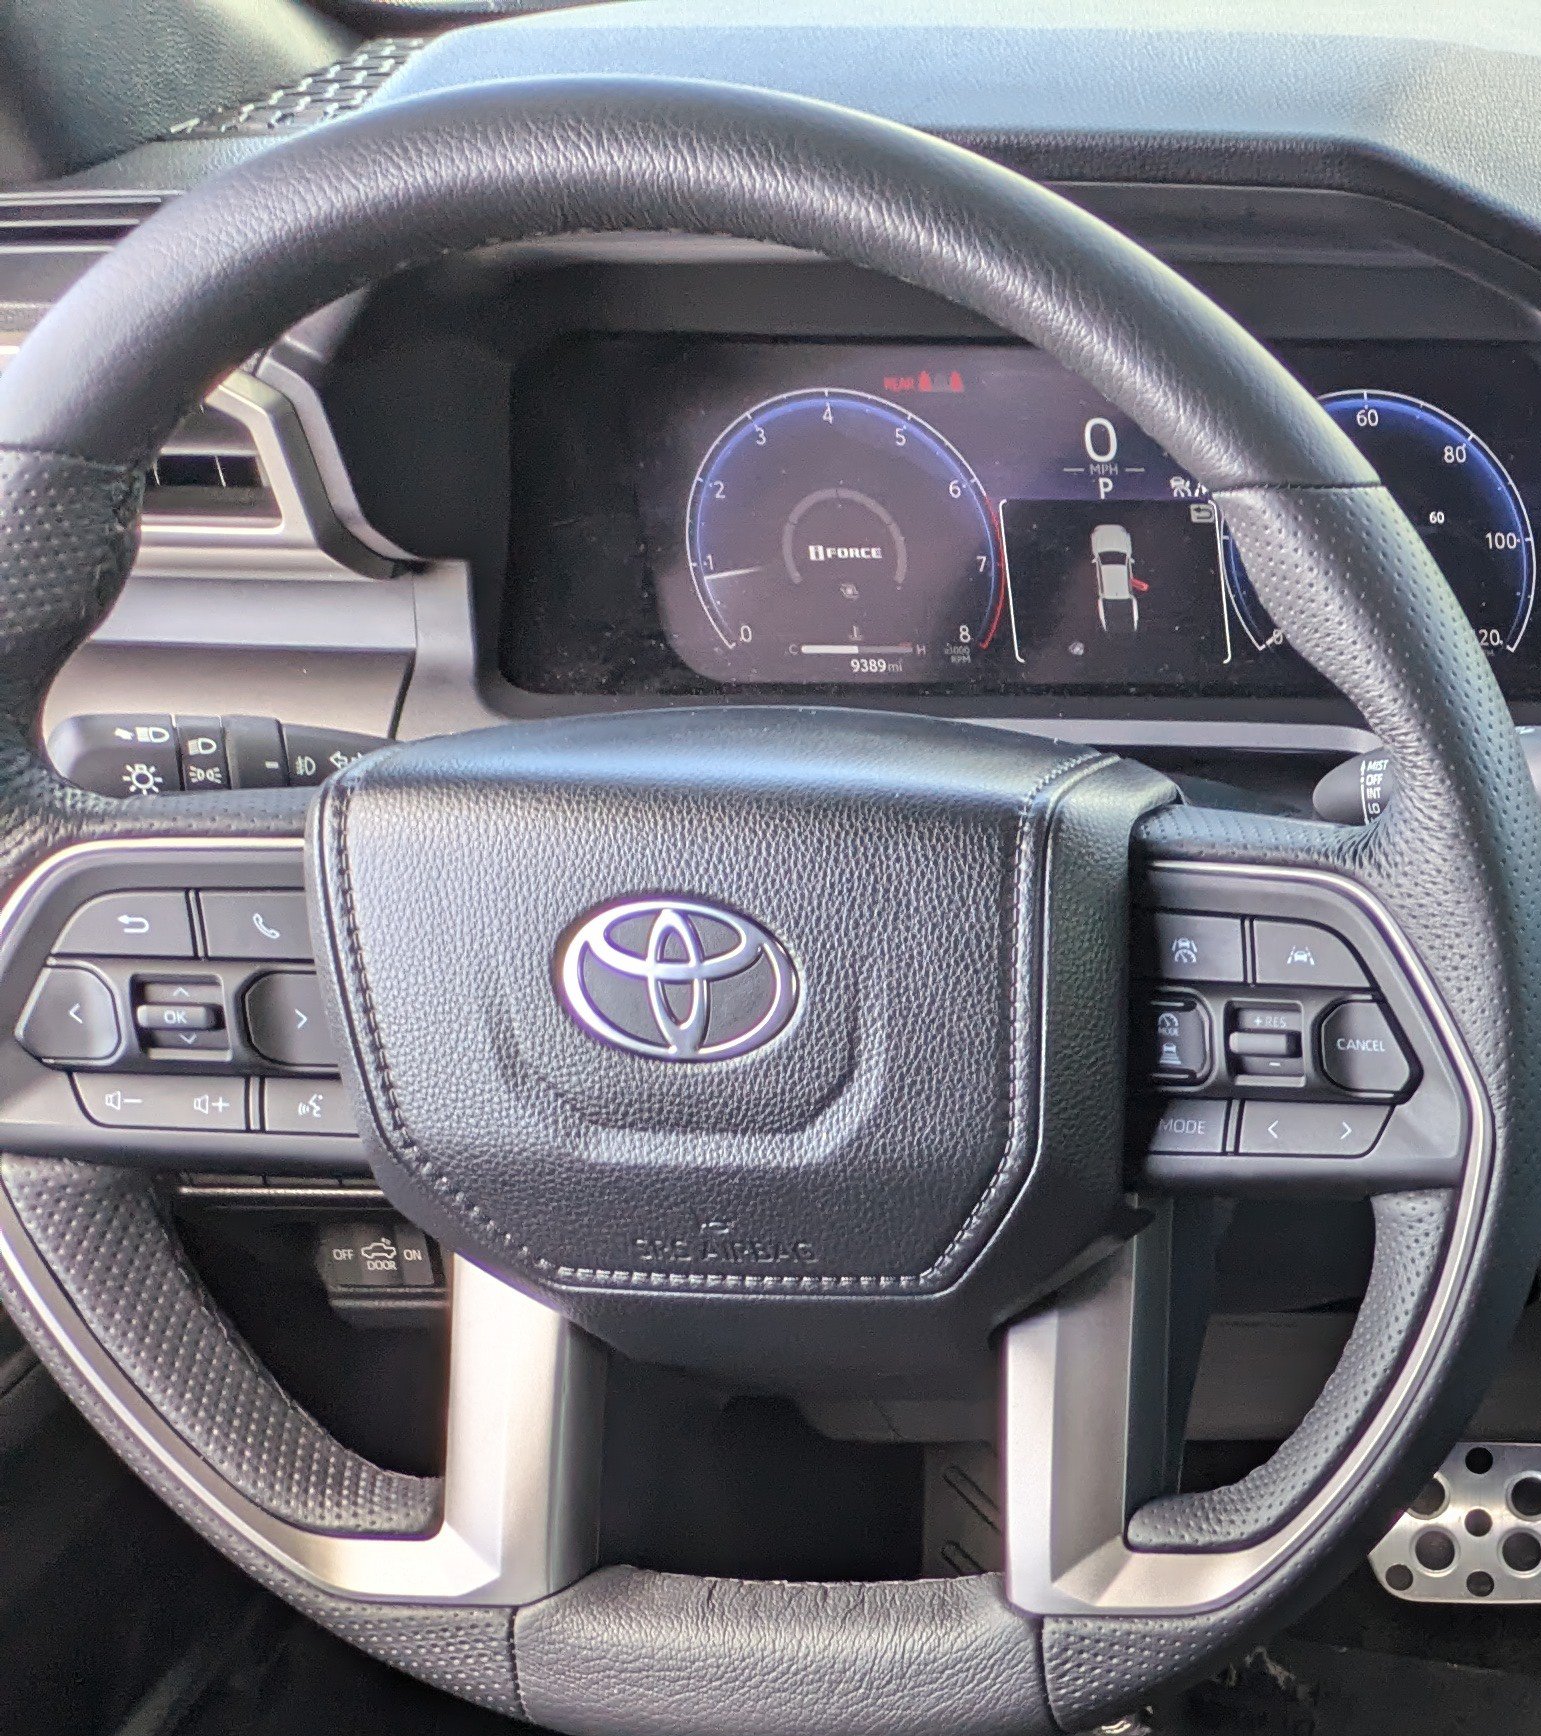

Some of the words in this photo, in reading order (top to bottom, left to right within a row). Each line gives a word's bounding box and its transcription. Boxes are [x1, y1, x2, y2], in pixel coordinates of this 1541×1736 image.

[822, 408, 833, 425] 4
[1356, 409, 1379, 427] 60
[756, 428, 767, 446] 3
[895, 428, 906, 446] 5
[1084, 417, 1117, 462] 0
[1443, 446, 1467, 464] 80
[1090, 463, 1118, 475] MPH
[714, 481, 725, 499] 2
[949, 480, 962, 498] 6
[1099, 477, 1113, 499] P
[1429, 511, 1445, 524] 60
[1485, 531, 1516, 550] 100
[826, 546, 883, 559] FORCE
[706, 556, 715, 571] 1
[977, 557, 987, 572] 7
[740, 626, 752, 643] 0
[959, 625, 971, 643] 8
[1478, 629, 1500, 646] 20
[850, 659, 886, 673] 9389
[1367, 759, 1389, 771] MIST
[1366, 773, 1383, 786] OFF
[1366, 787, 1381, 799] INT
[164, 1010, 187, 1024] OK
[1337, 1038, 1386, 1051] CANCEL
[1159, 1119, 1206, 1135] MODE
[332, 1248, 354, 1260] OFF
[403, 1249, 422, 1261] ON
[367, 1260, 398, 1271] DOOR
